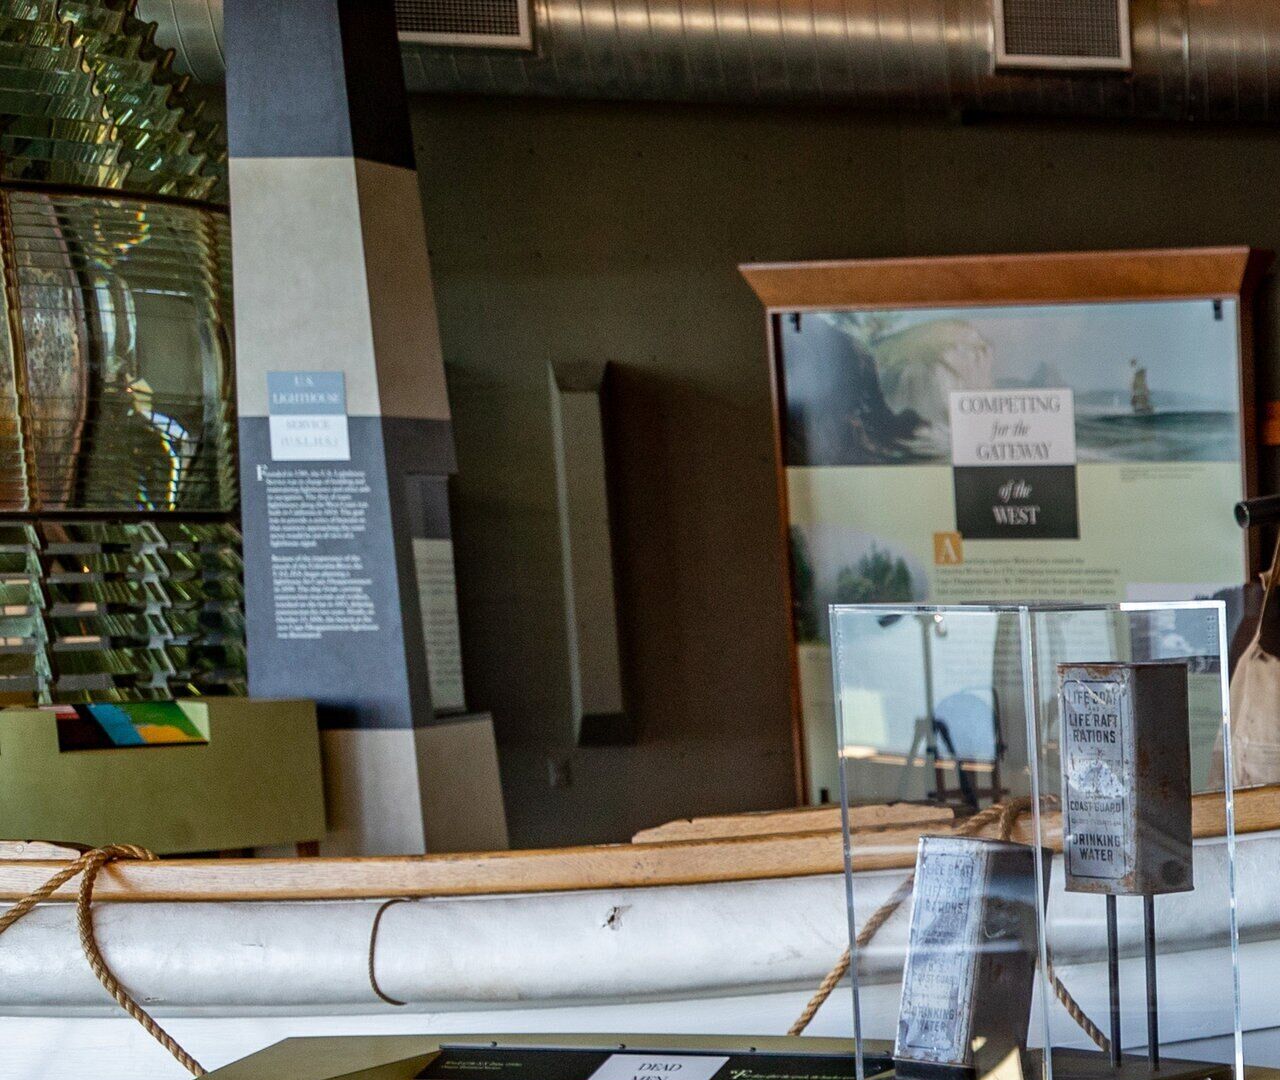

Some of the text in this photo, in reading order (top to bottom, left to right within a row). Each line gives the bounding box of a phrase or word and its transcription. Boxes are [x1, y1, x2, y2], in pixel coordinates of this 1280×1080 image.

[958, 396, 1061, 415] COMPETING
[990, 419, 1030, 438] for the
[975, 442, 1051, 461] GATEWAY
[998, 479, 1032, 499] of the
[992, 505, 1040, 525] WEST
[1069, 713, 1118, 728] LIFE RAFT
[1073, 729, 1116, 744] RATIONS
[1072, 833, 1120, 847] DRINKING
[1079, 847, 1114, 862] WATER
[638, 1062, 682, 1072] DEAD
